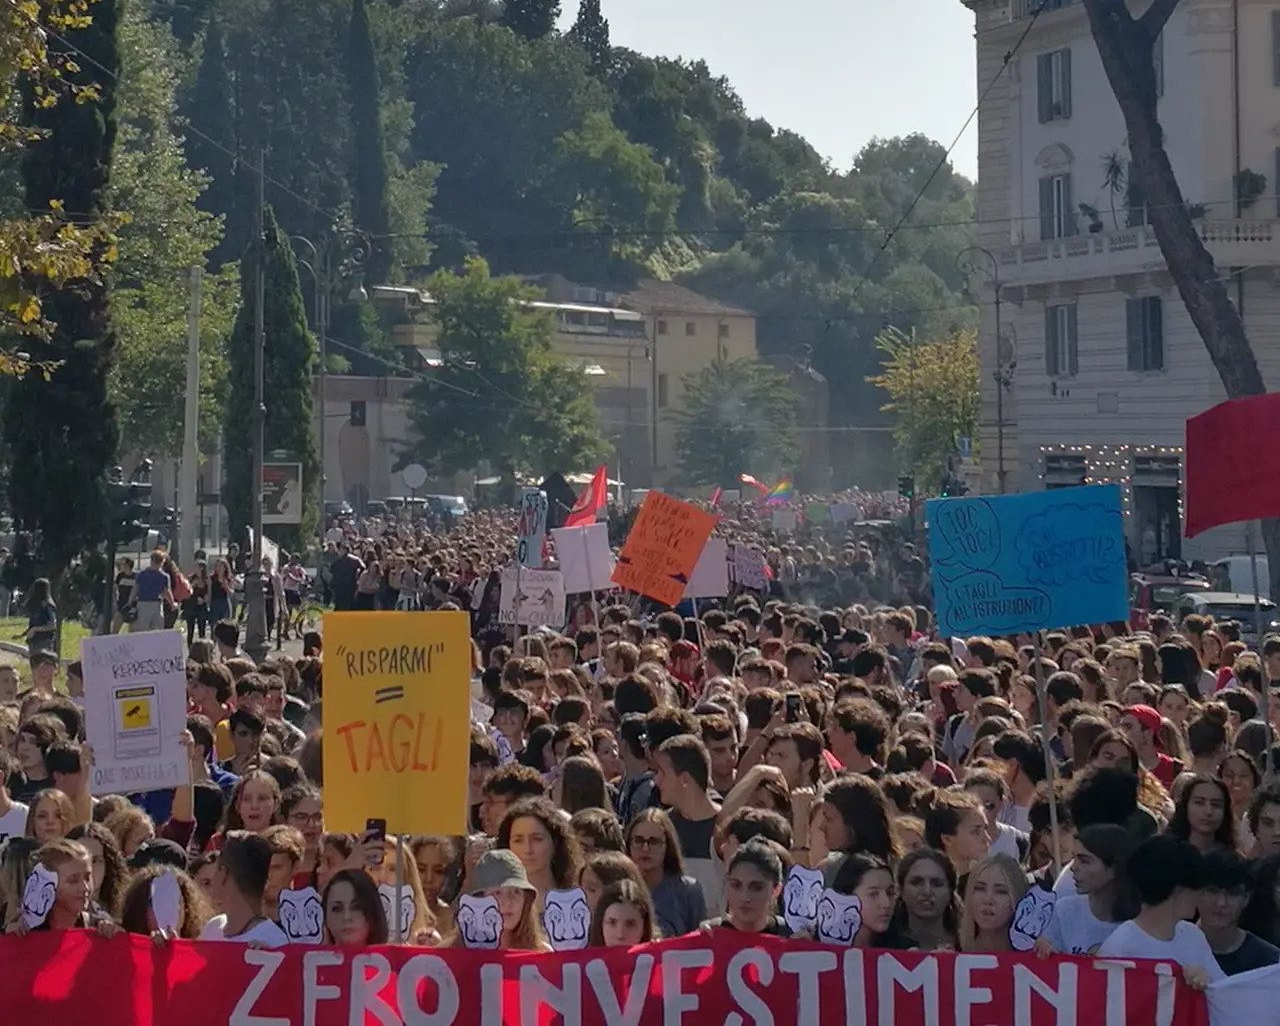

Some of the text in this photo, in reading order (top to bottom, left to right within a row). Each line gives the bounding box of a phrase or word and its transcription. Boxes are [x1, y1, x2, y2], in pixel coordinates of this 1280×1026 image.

[946, 506, 978, 534] TOC
[963, 582, 997, 601] TAGLI
[111, 655, 185, 679] REPRESSIONE
[336, 642, 445, 679] "RISPARMI"
[336, 712, 445, 774] TAGLI
